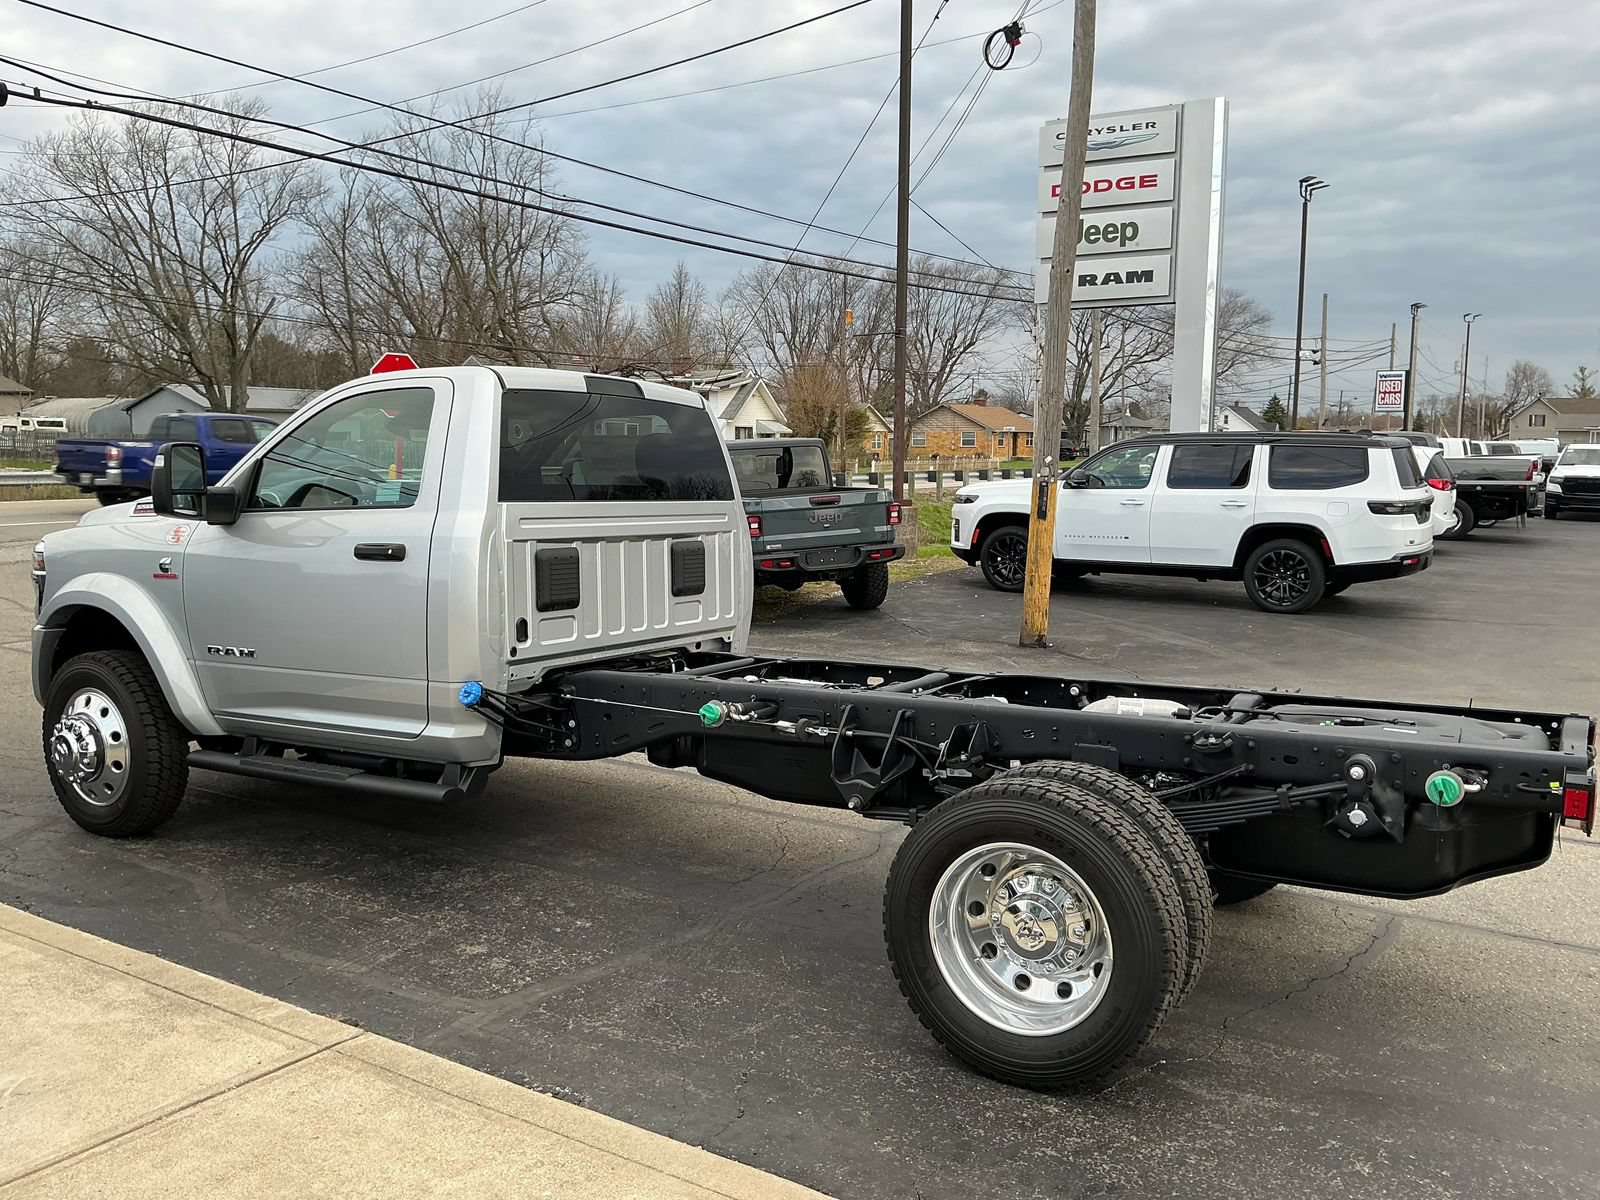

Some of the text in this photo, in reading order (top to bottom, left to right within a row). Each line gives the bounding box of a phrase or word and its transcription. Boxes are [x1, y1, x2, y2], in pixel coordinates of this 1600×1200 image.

[1078, 270, 1154, 287] RAM
[1380, 381, 1401, 392] USED
[1379, 393, 1401, 404] CARS
[809, 511, 843, 524] Jeep
[207, 645, 257, 658] RAM
